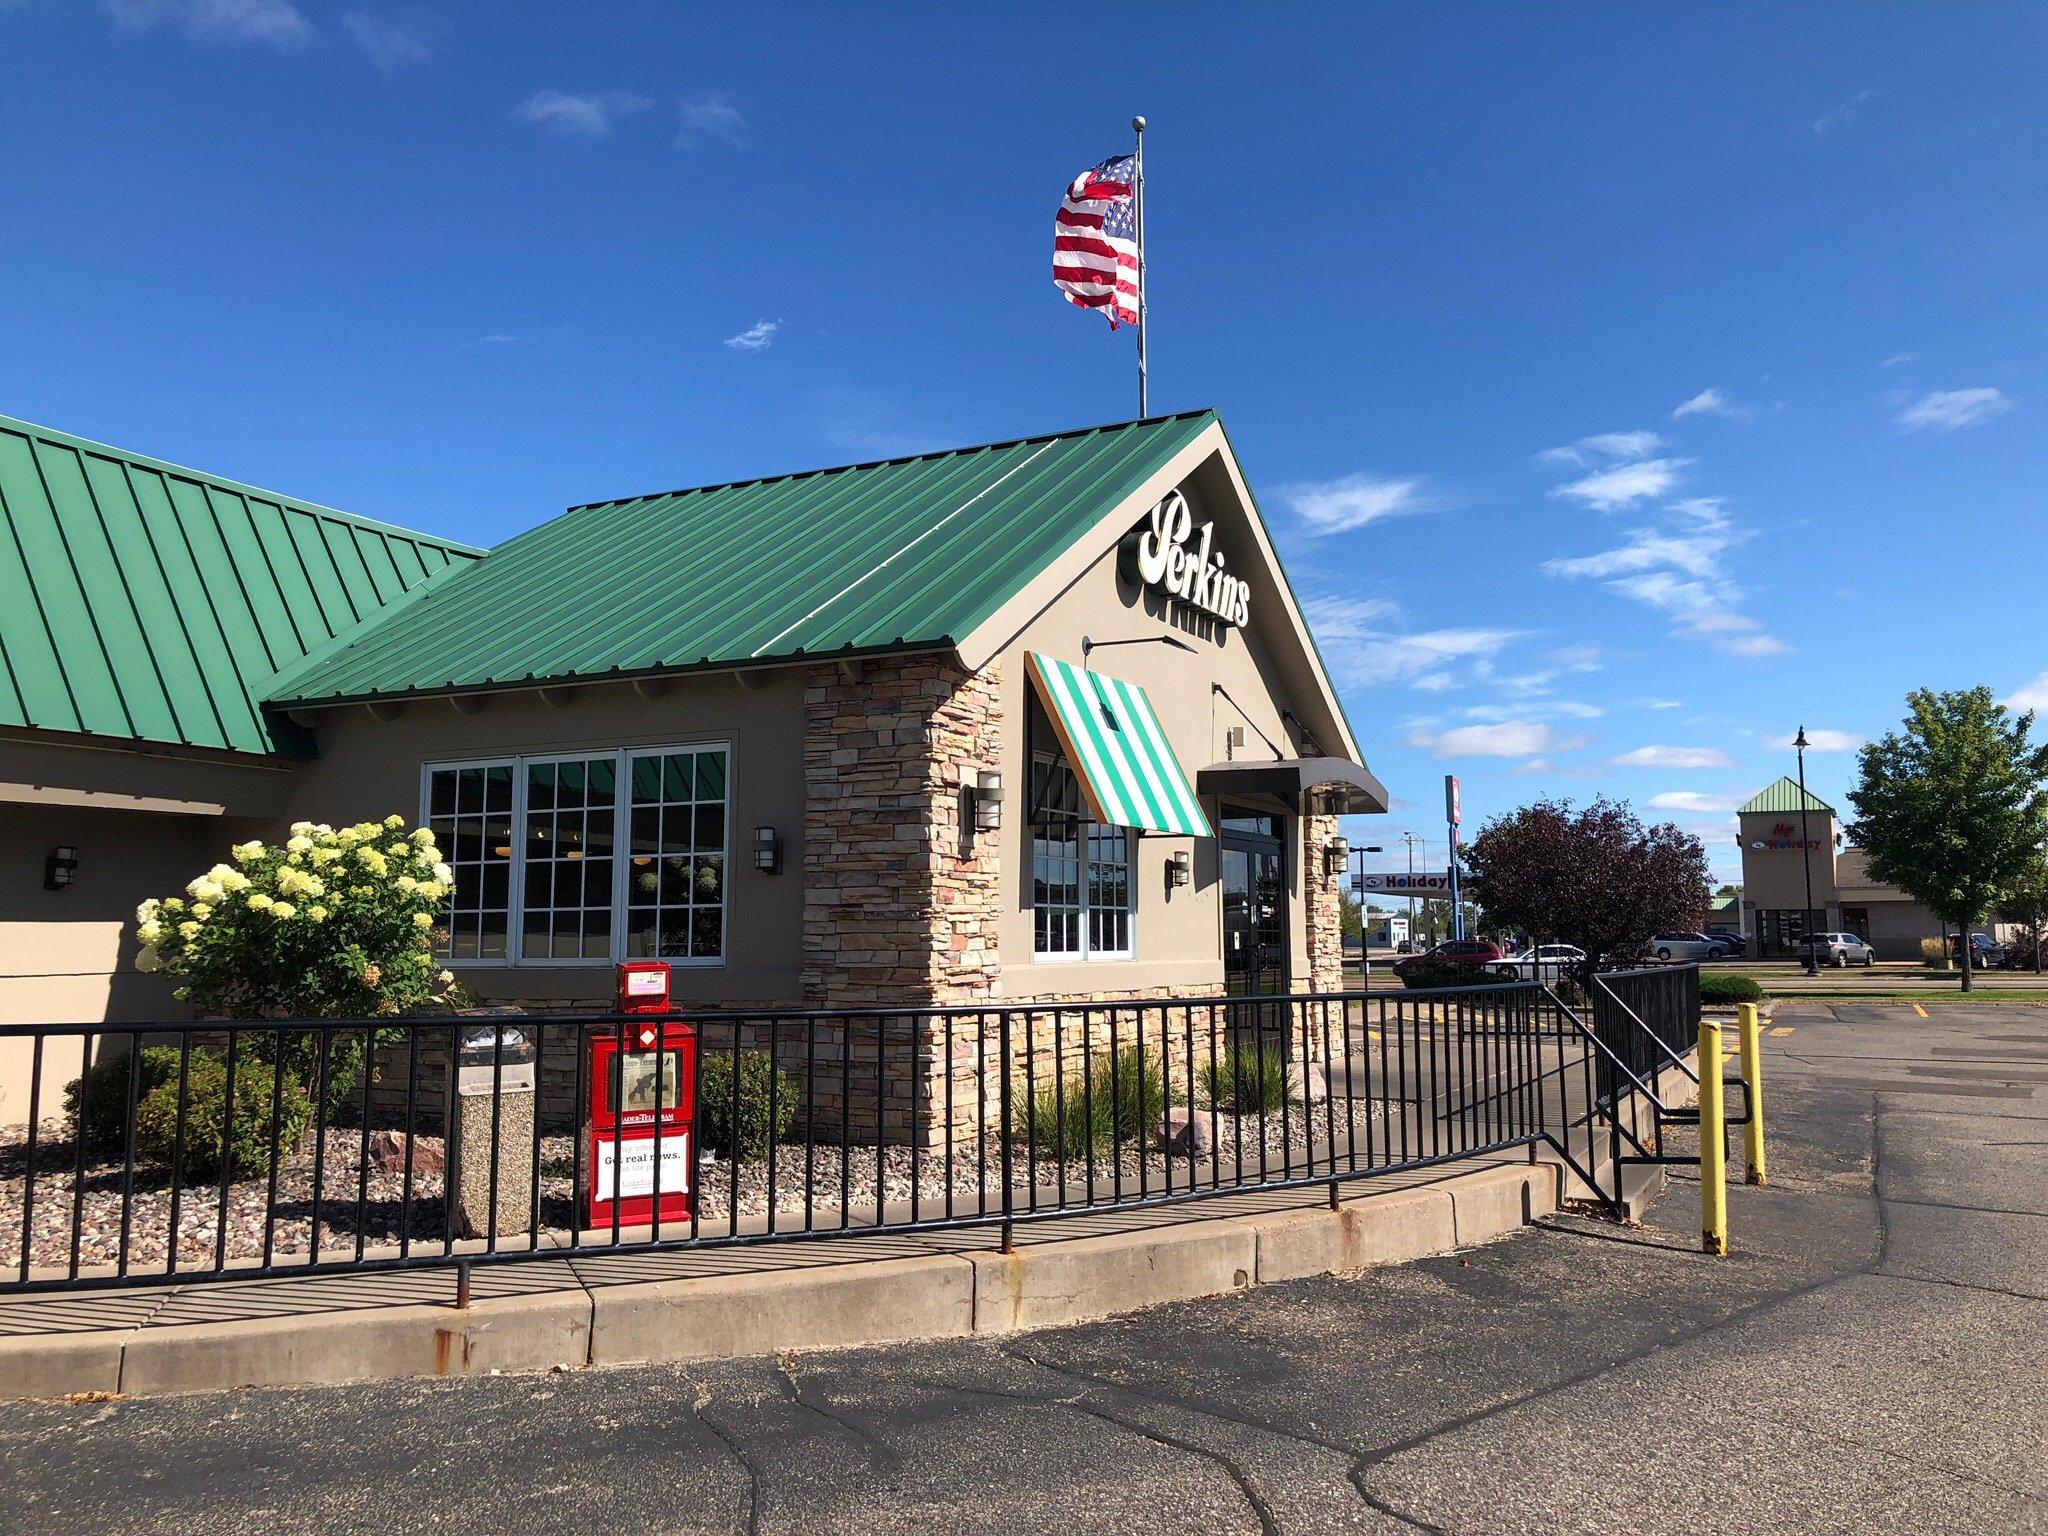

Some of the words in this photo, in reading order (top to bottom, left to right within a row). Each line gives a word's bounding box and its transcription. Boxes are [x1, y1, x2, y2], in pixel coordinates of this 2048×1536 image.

[1137, 488, 1250, 628] Perkins
[1386, 875, 1449, 890] Holiday
[626, 1154, 648, 1163] real
